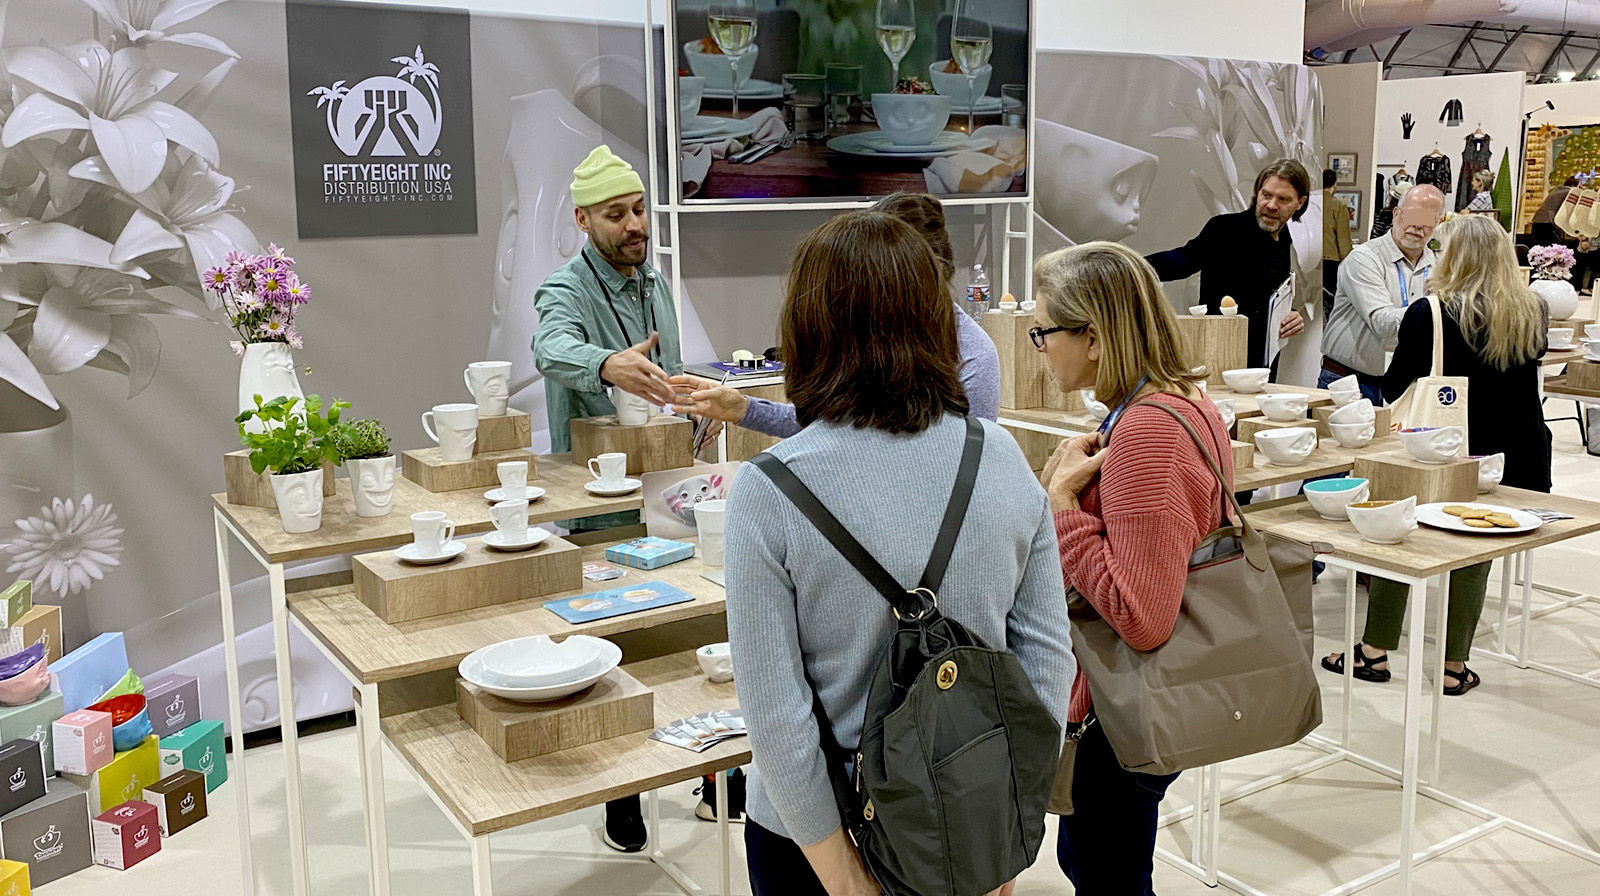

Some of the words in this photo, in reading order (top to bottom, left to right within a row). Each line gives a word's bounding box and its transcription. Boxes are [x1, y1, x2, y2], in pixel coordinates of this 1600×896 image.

[323, 164, 419, 181] FIFTYEIGHT
[424, 163, 451, 180] INC
[324, 181, 419, 195] DISTRIBUTION
[425, 181, 452, 194] USA
[325, 194, 453, 203] FIFTYEIGHT-INC.COM
